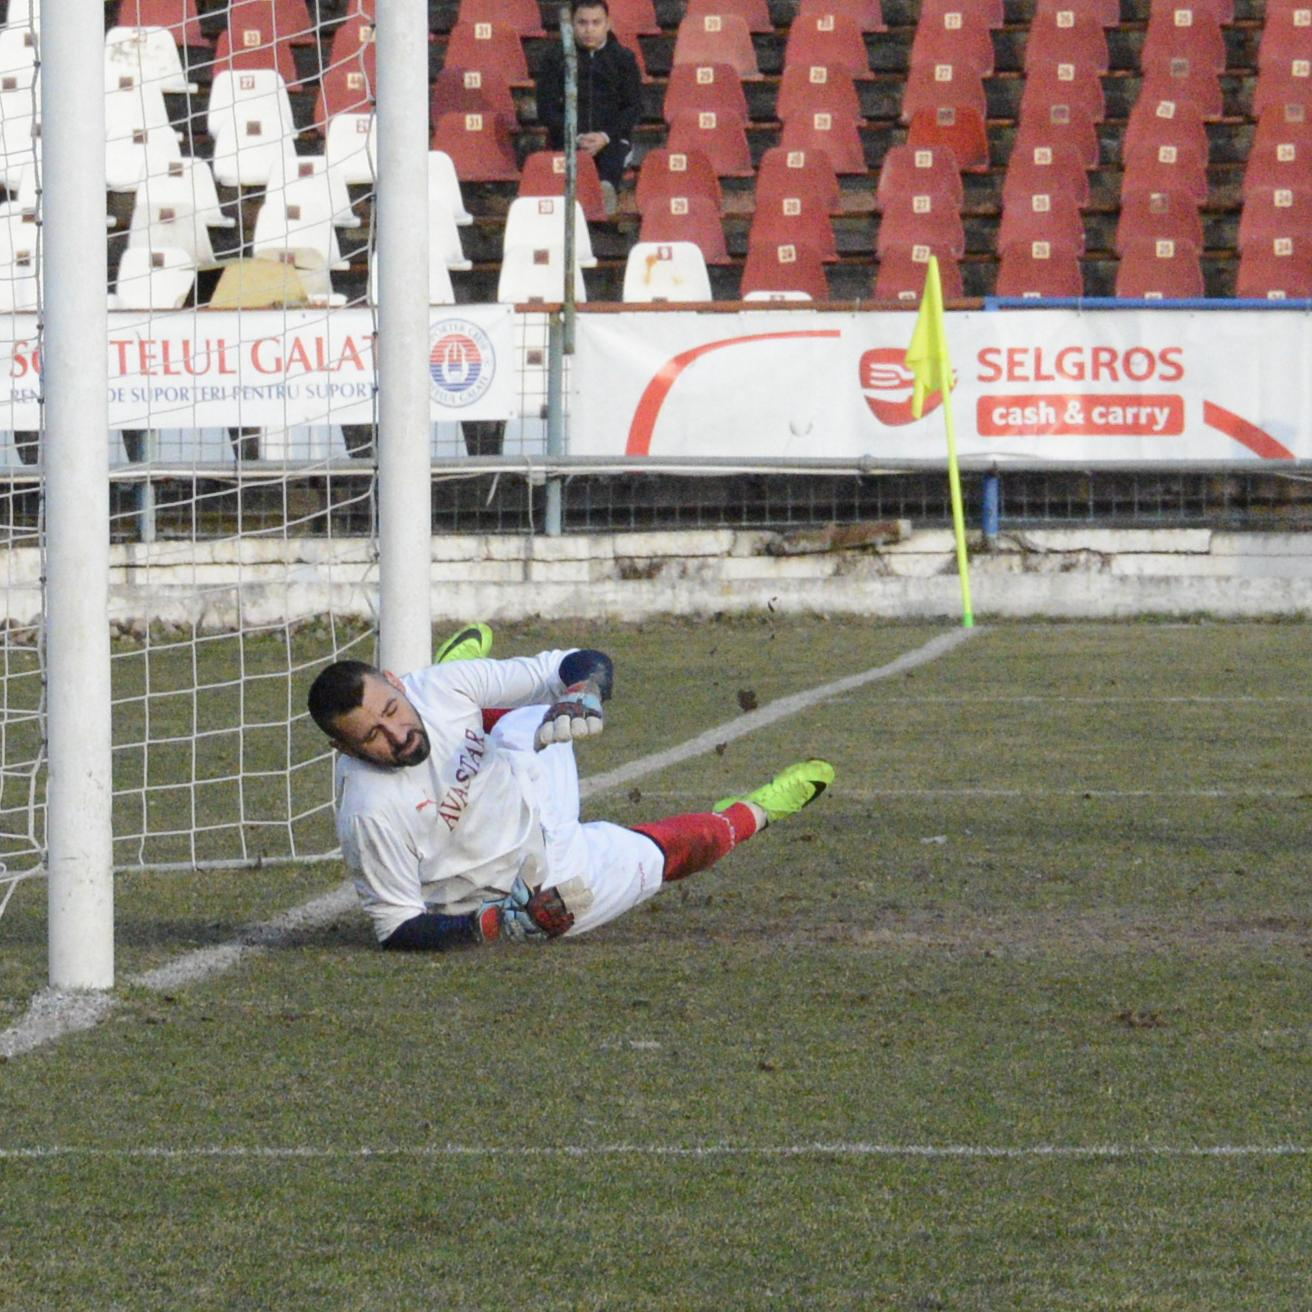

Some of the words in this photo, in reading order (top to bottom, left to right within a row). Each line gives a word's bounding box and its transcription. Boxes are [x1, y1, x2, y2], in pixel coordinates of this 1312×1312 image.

[109, 338, 237, 376] TELUL
[250, 335, 380, 374] GALAT
[977, 346, 1185, 383] SELGROS
[306, 383, 375, 399] SUPORT
[992, 403, 1056, 426] cash
[1064, 400, 1085, 425] &
[1091, 404, 1170, 431] carry
[438, 728, 485, 832] AVASTAR
